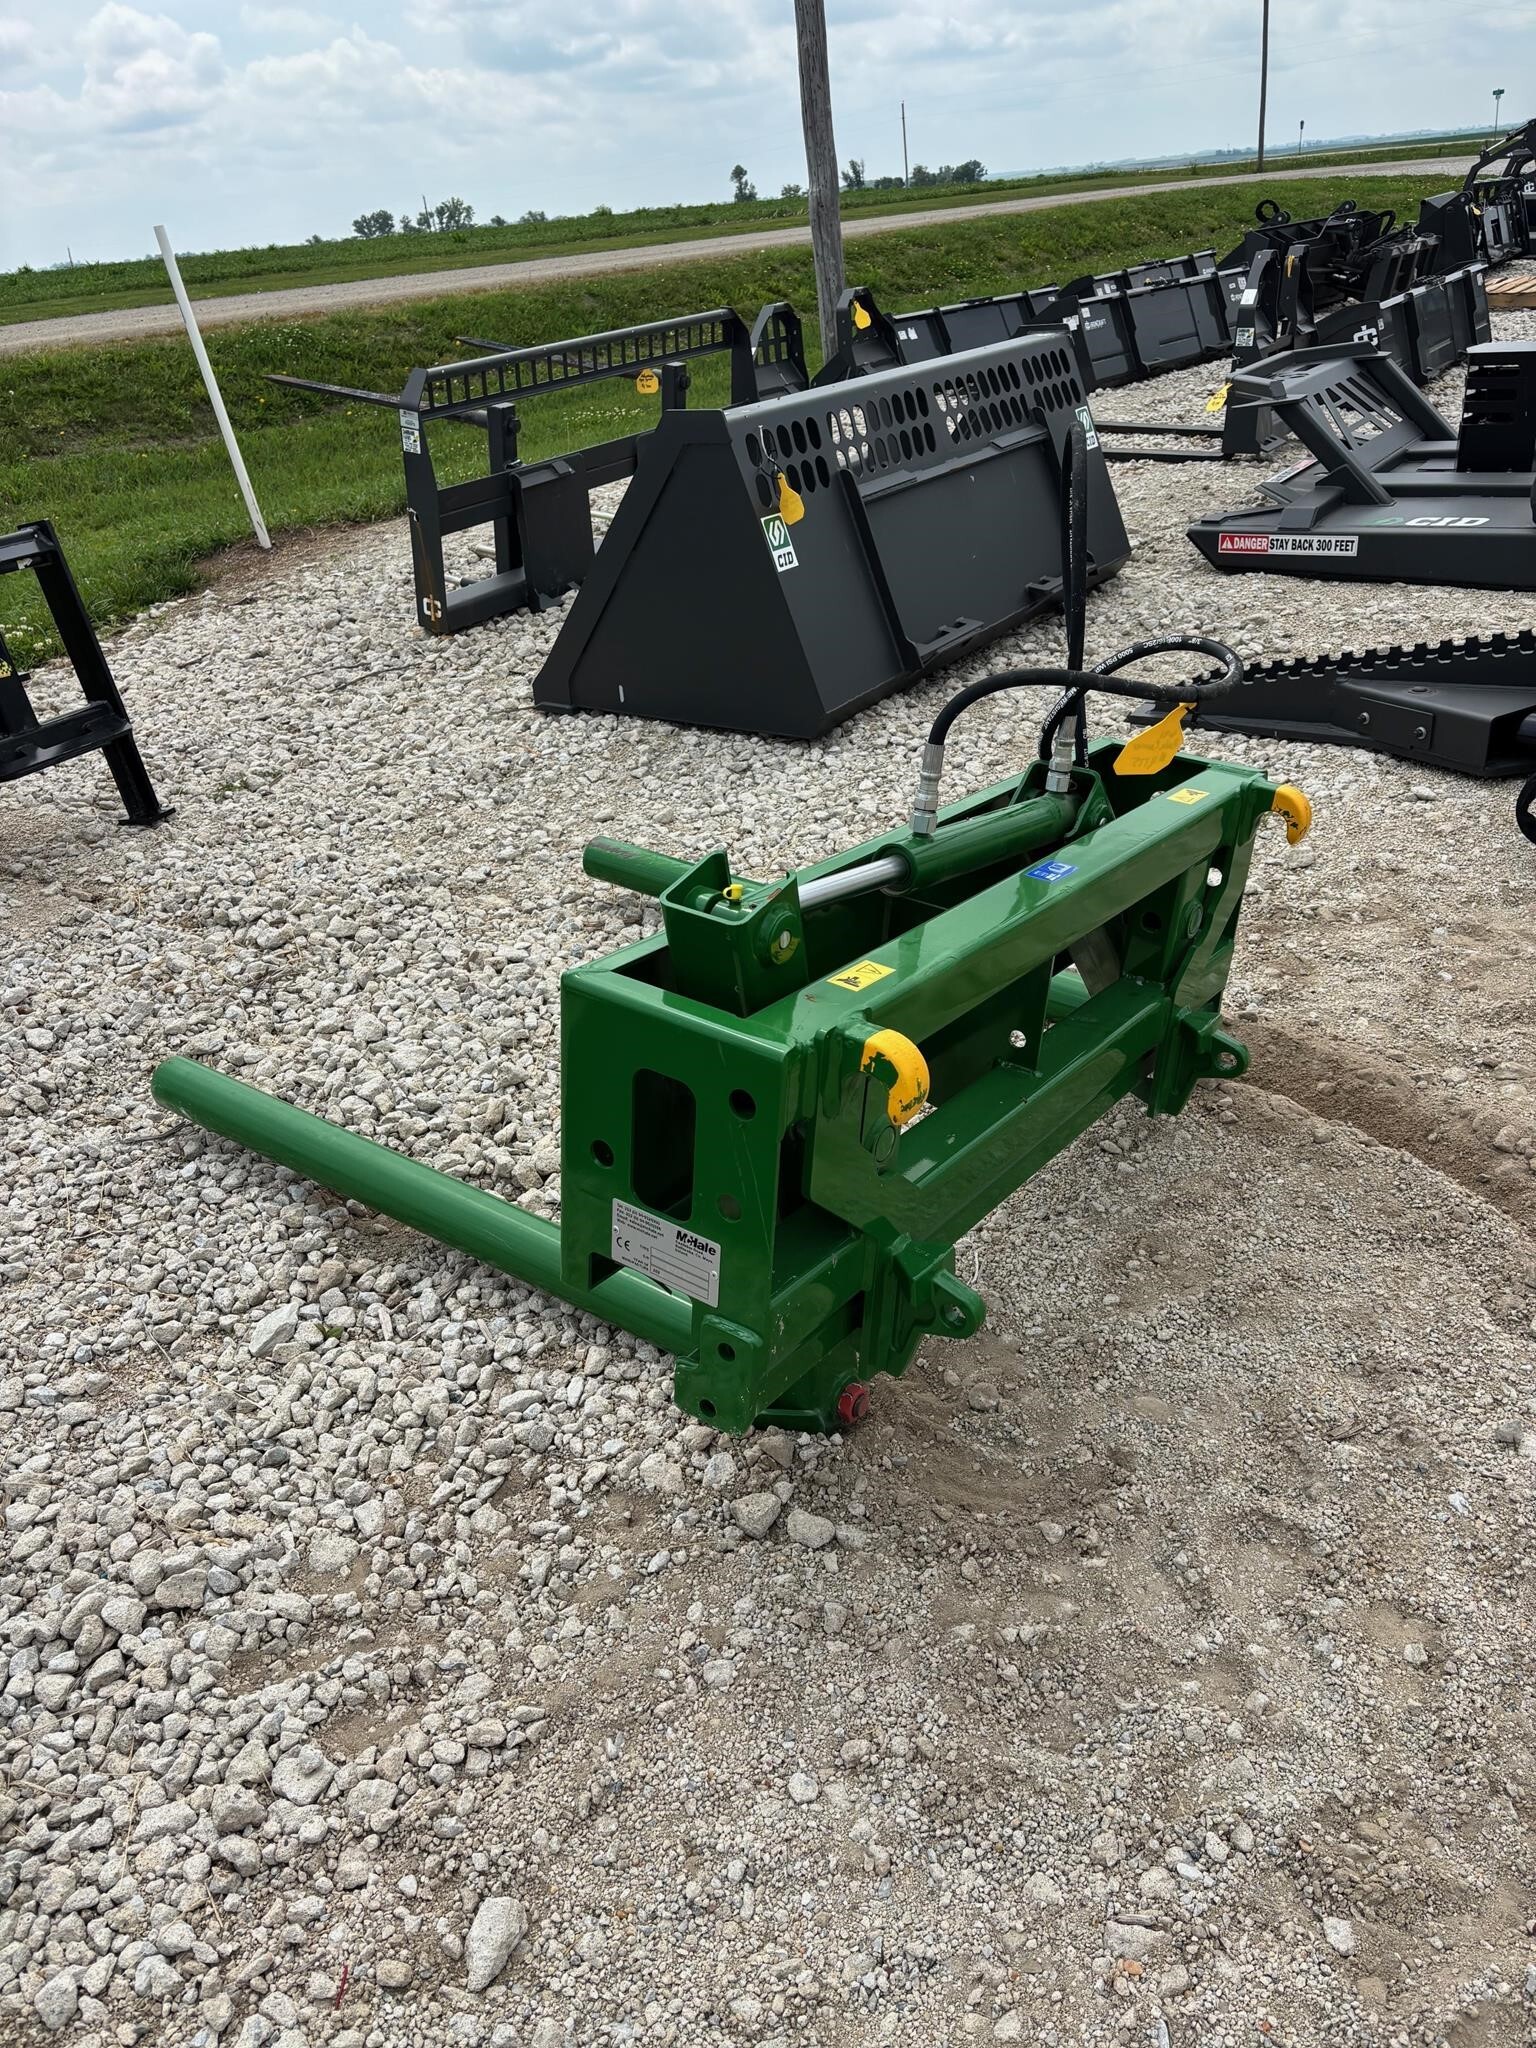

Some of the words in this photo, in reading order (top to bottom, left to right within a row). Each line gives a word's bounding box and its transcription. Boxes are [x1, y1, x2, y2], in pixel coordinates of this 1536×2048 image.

[1405, 517, 1490, 526] CID
[1233, 537, 1268, 550] DANGER
[1269, 538, 1290, 550] STAY
[1291, 539, 1314, 551] BACK
[1316, 539, 1332, 551] 300
[1334, 540, 1355, 552] FEET
[777, 551, 794, 568] CID
[1106, 655, 1117, 666] PSI
[1118, 647, 1134, 660] 5000
[1044, 696, 1068, 730] RESISTANT
[617, 1237, 630, 1251] CE
